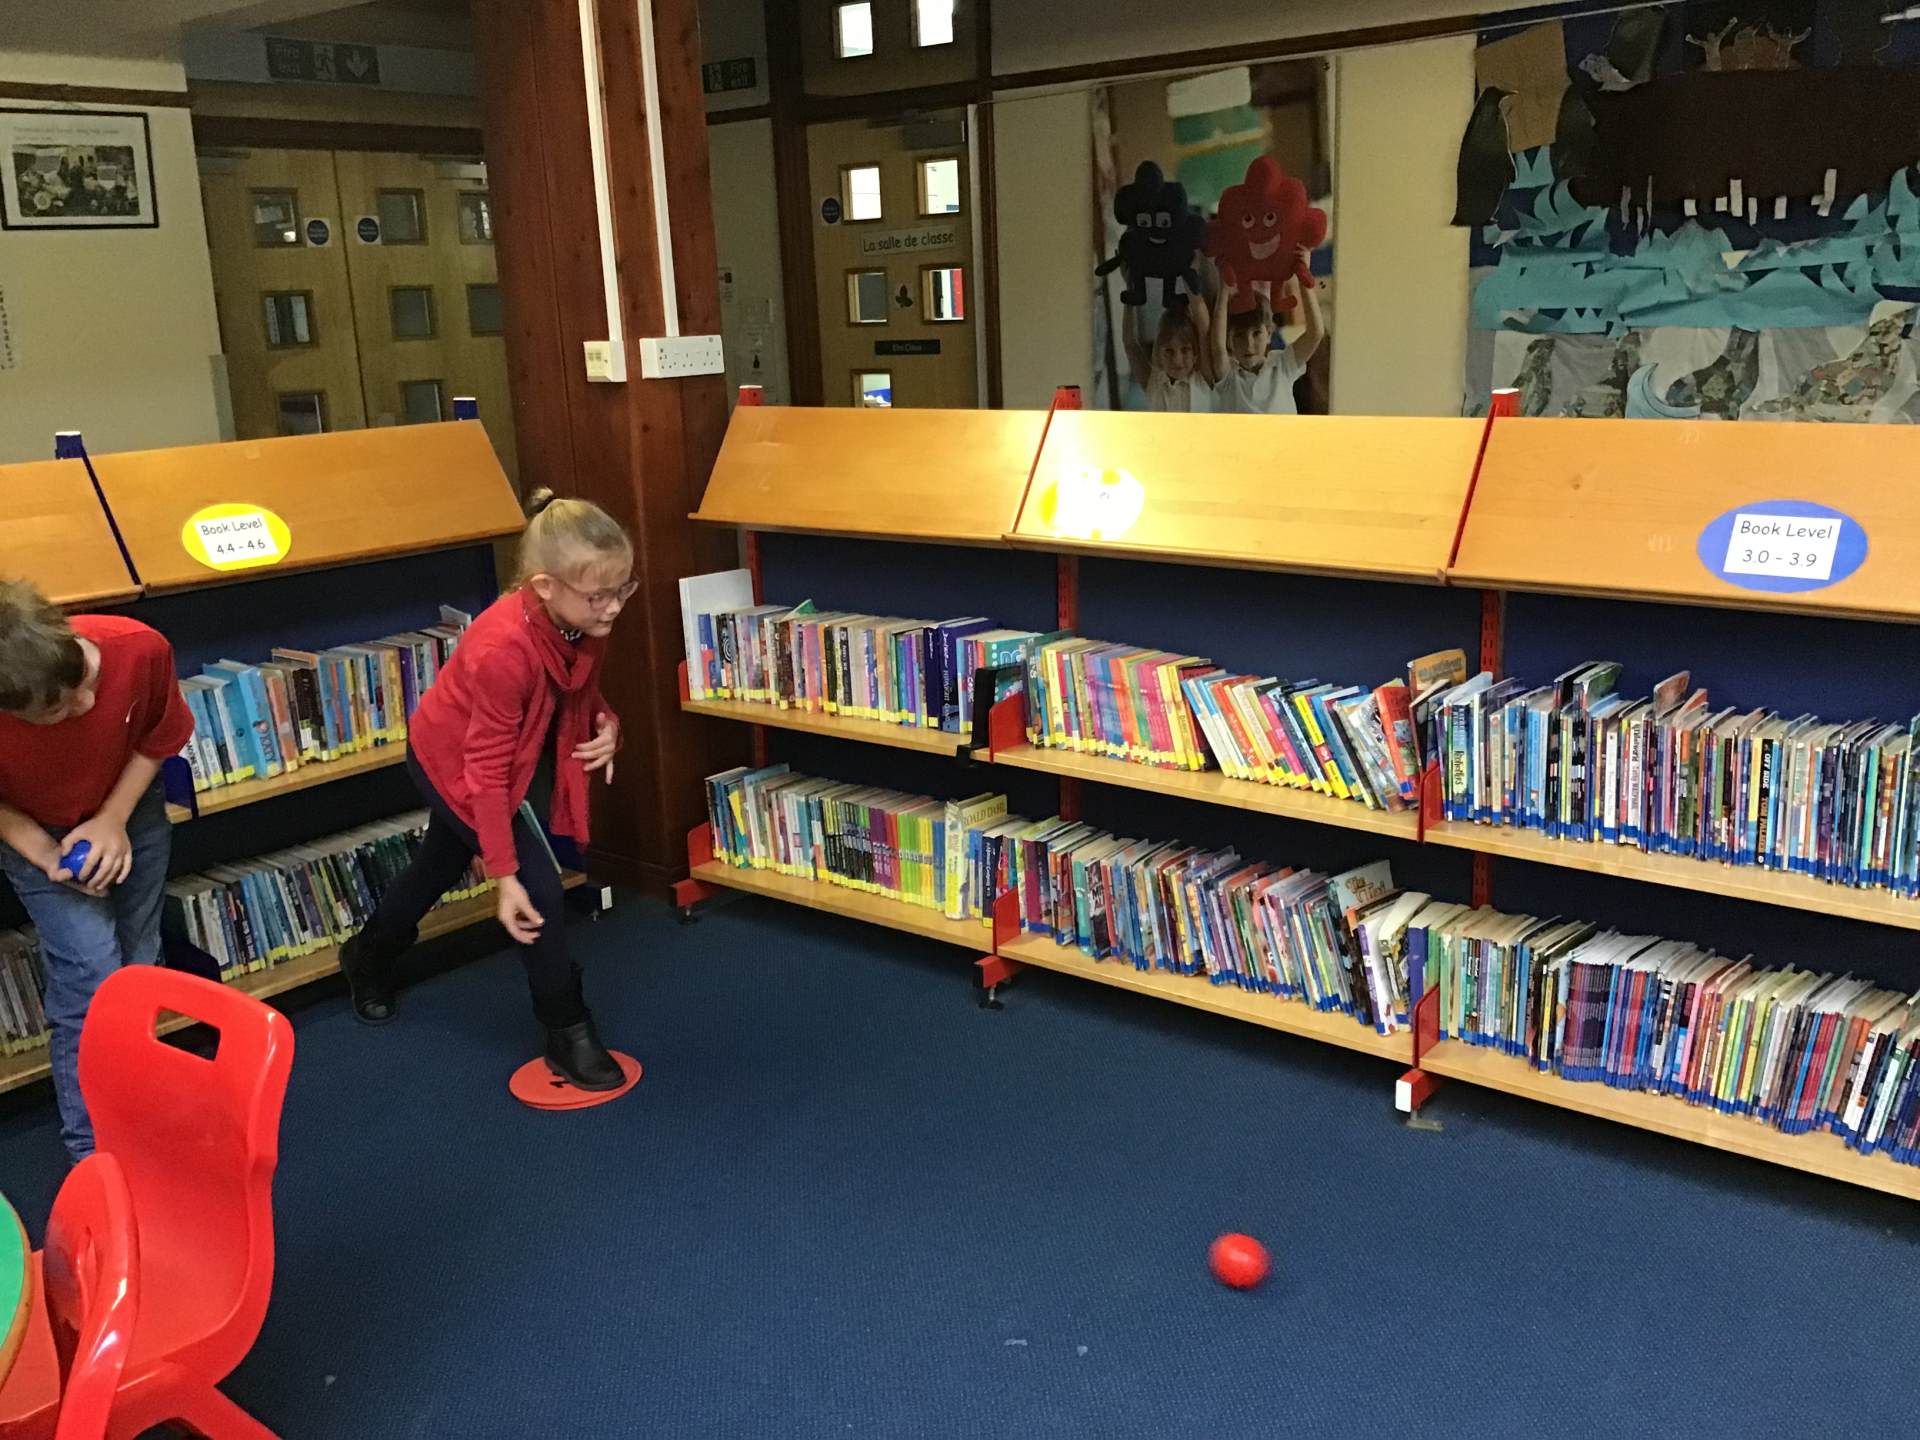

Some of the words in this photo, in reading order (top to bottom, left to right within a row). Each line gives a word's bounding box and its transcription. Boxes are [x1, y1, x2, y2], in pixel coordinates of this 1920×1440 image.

[863, 239, 876, 252] La
[878, 236, 902, 250] salle
[904, 234, 918, 247] de
[921, 232, 954, 246] classe
[200, 524, 231, 536] Book
[232, 517, 264, 532] Level
[1740, 520, 1782, 536] Book
[1786, 522, 1834, 540] Level
[1763, 753, 1772, 770] OFF
